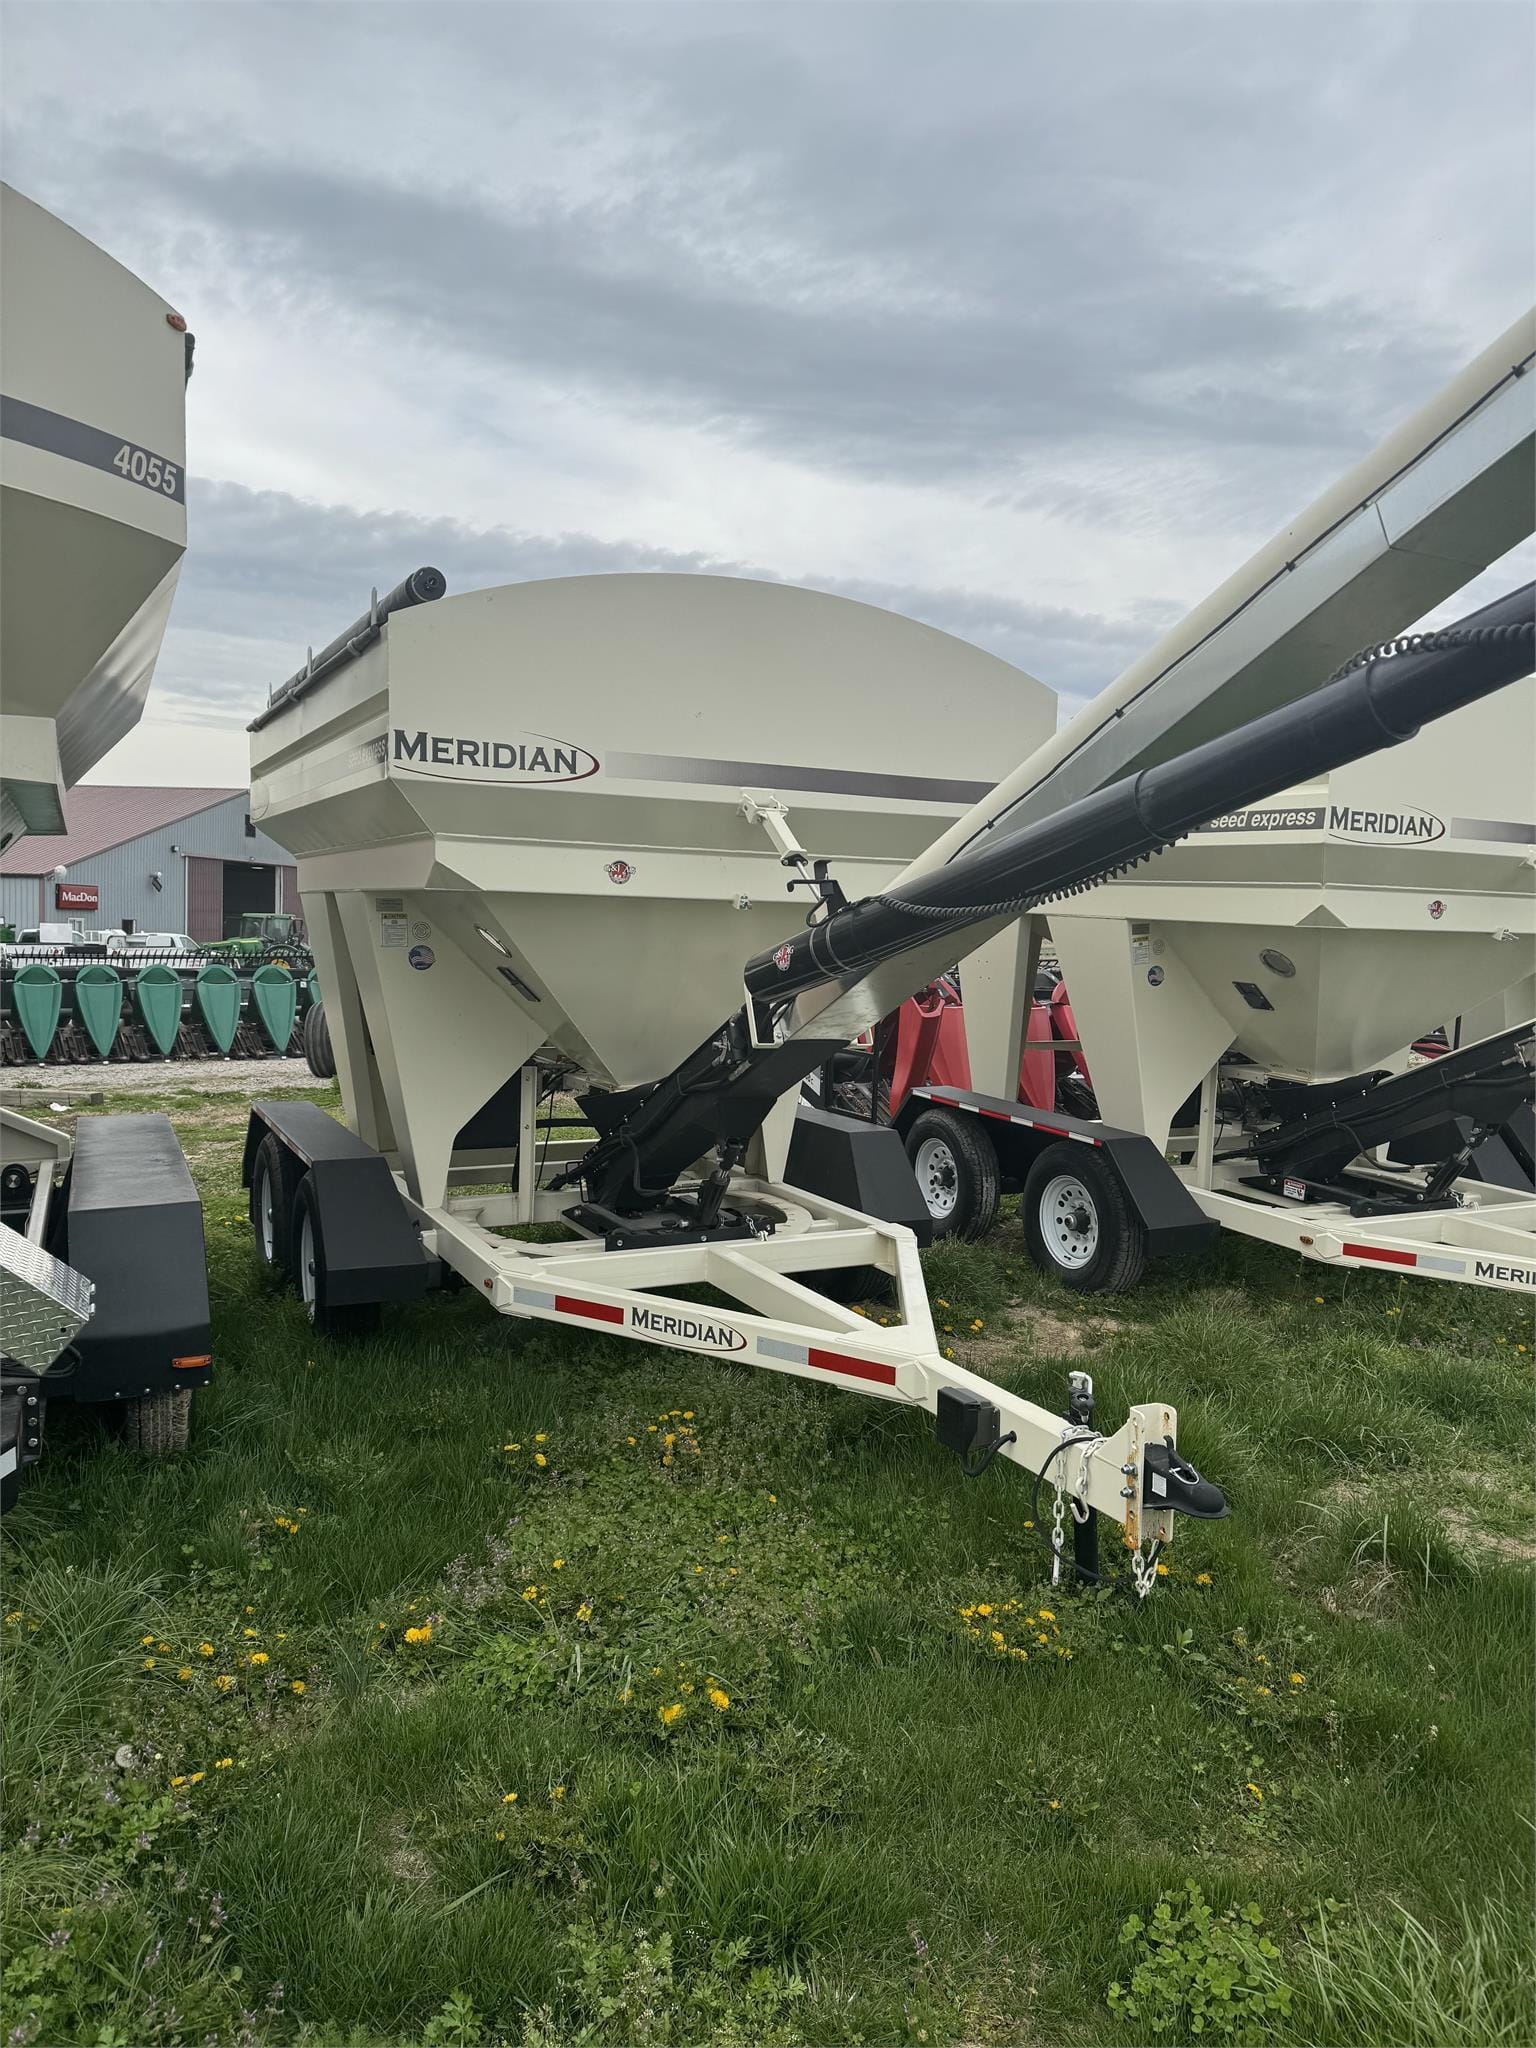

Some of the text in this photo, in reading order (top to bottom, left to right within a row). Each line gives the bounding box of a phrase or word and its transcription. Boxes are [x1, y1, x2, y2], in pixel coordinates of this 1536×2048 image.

[113, 445, 177, 494] 4055
[393, 729, 578, 775] MERIDIAN
[1210, 810, 1317, 830] seed express
[1329, 806, 1434, 837] MERIDIAN
[62, 891, 98, 903] MacDon
[631, 1307, 734, 1348] MERIDIAN
